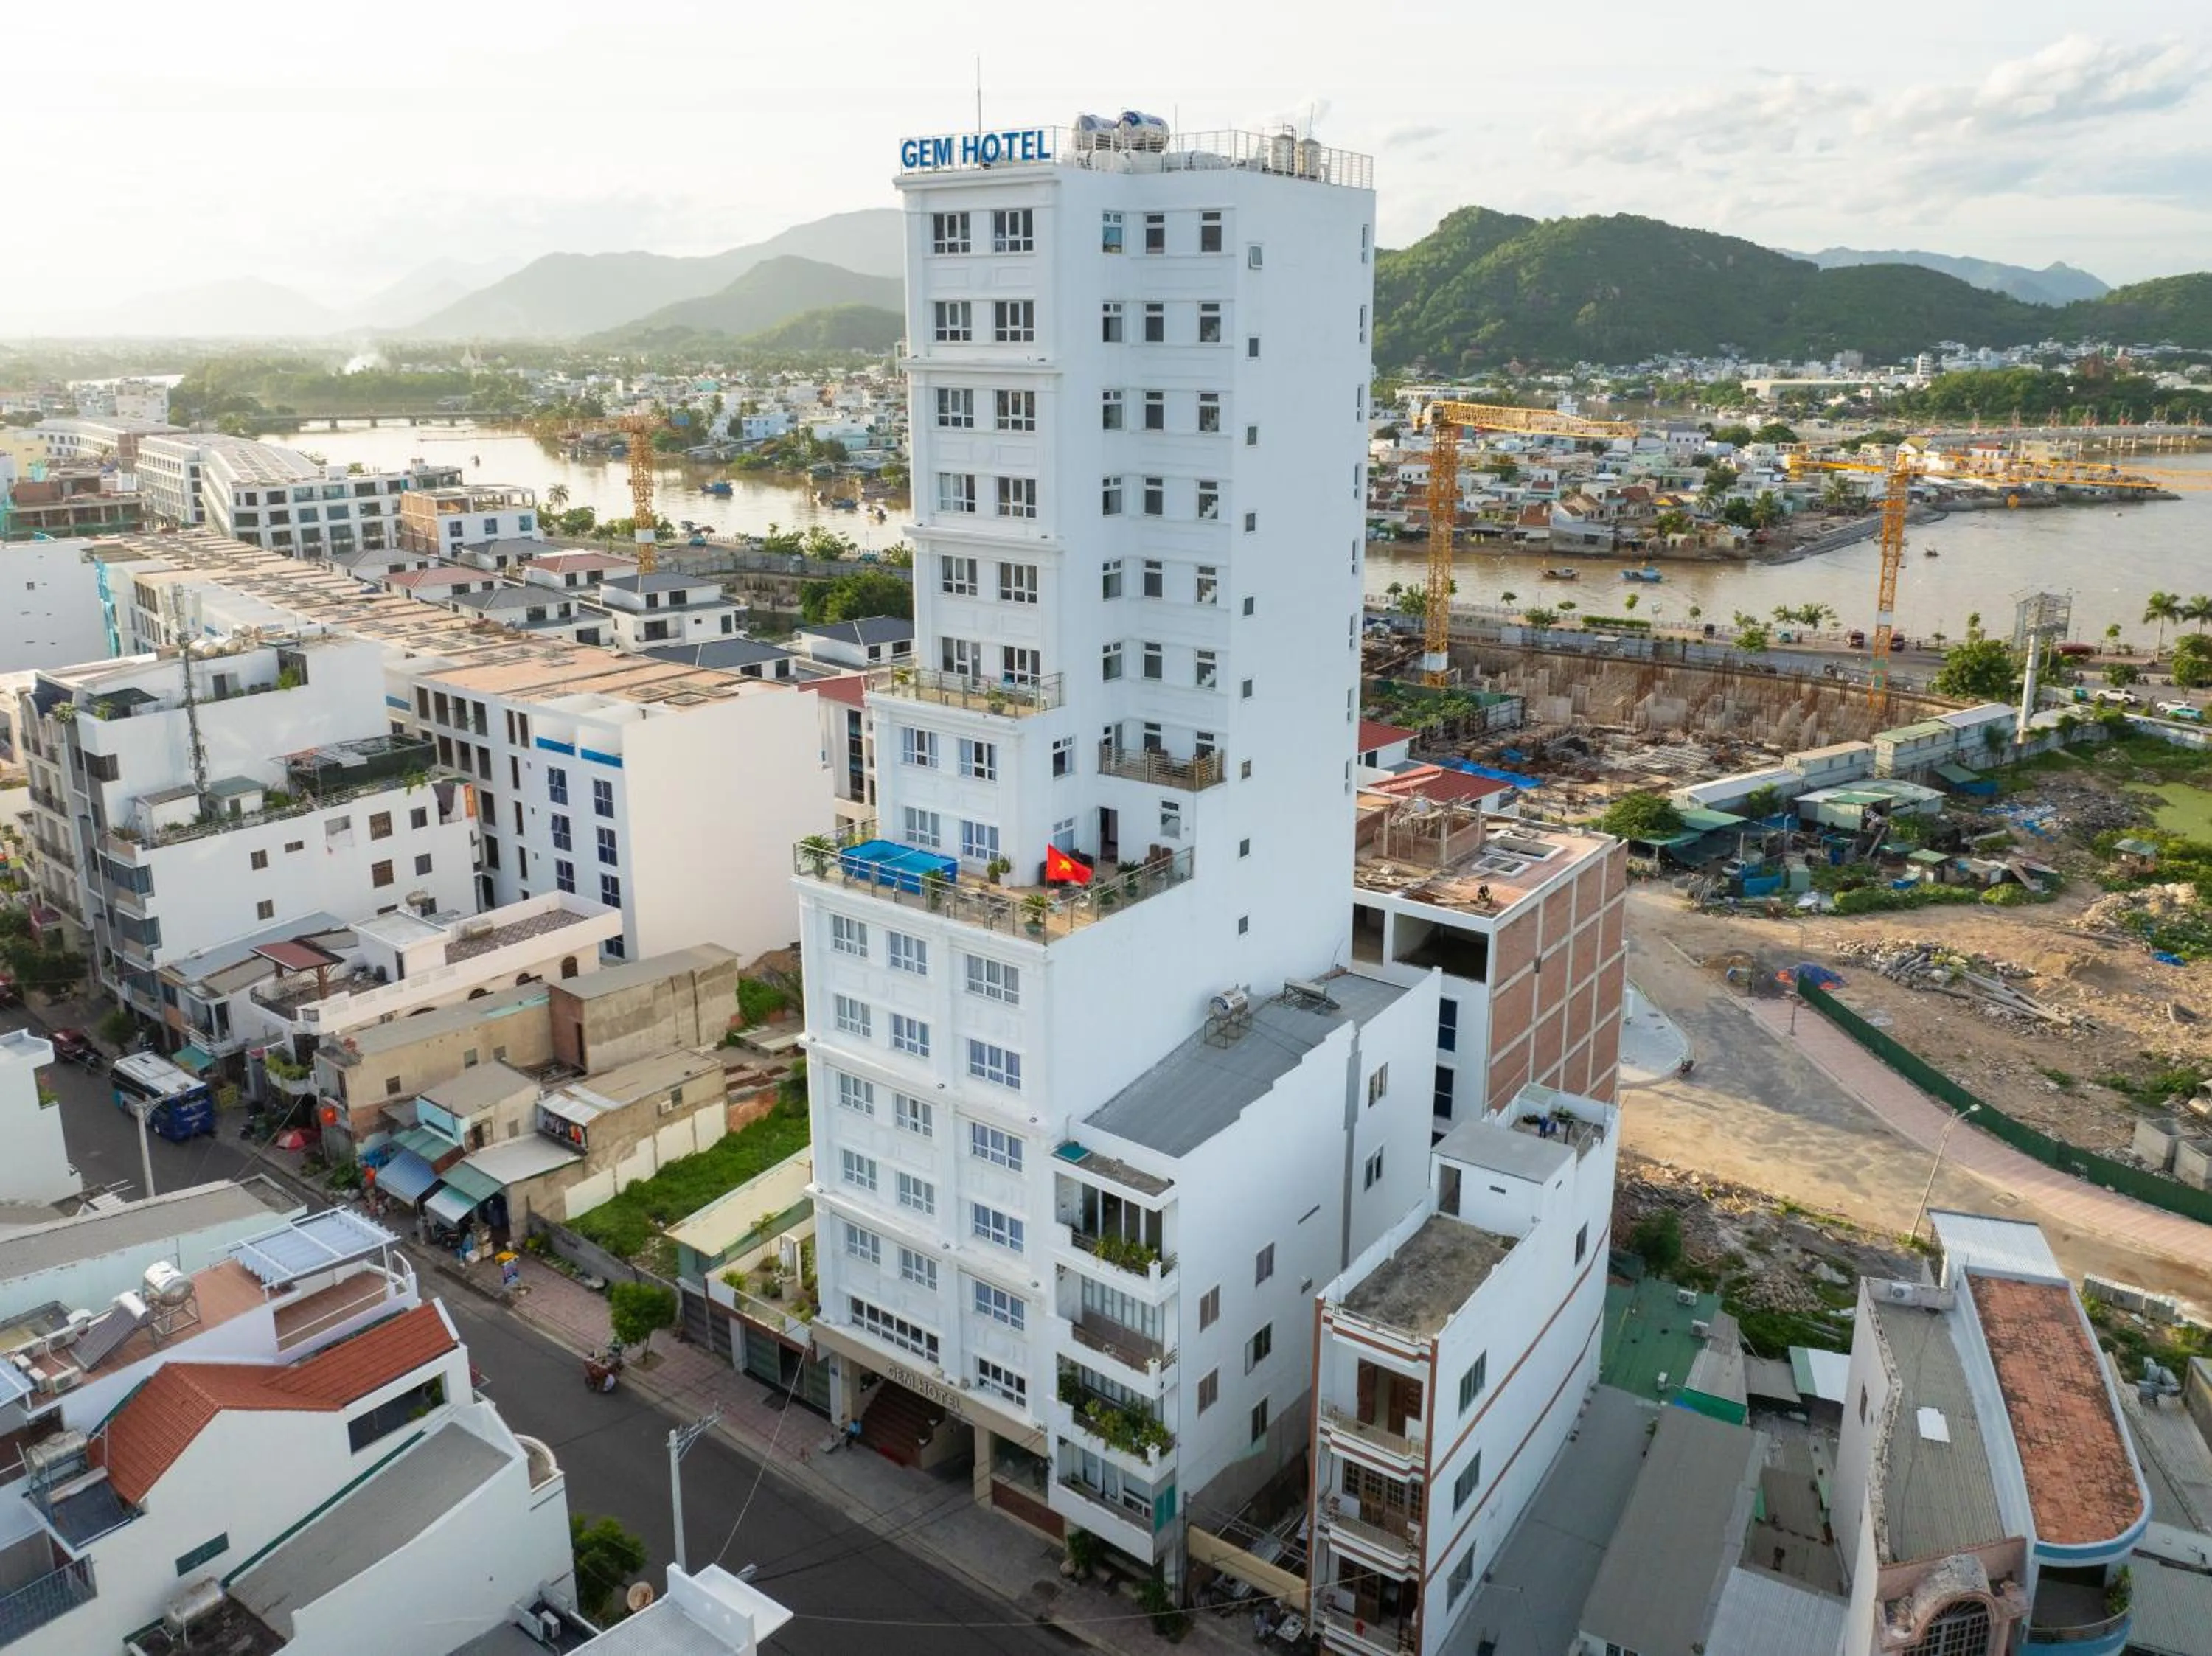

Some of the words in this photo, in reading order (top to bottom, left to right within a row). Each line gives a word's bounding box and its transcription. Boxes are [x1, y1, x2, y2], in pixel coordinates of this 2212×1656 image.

[902, 137, 952, 168] GEM
[962, 130, 1050, 164] HOTEL
[886, 1365, 914, 1385] GEM
[918, 1379, 961, 1412] HOTEL
